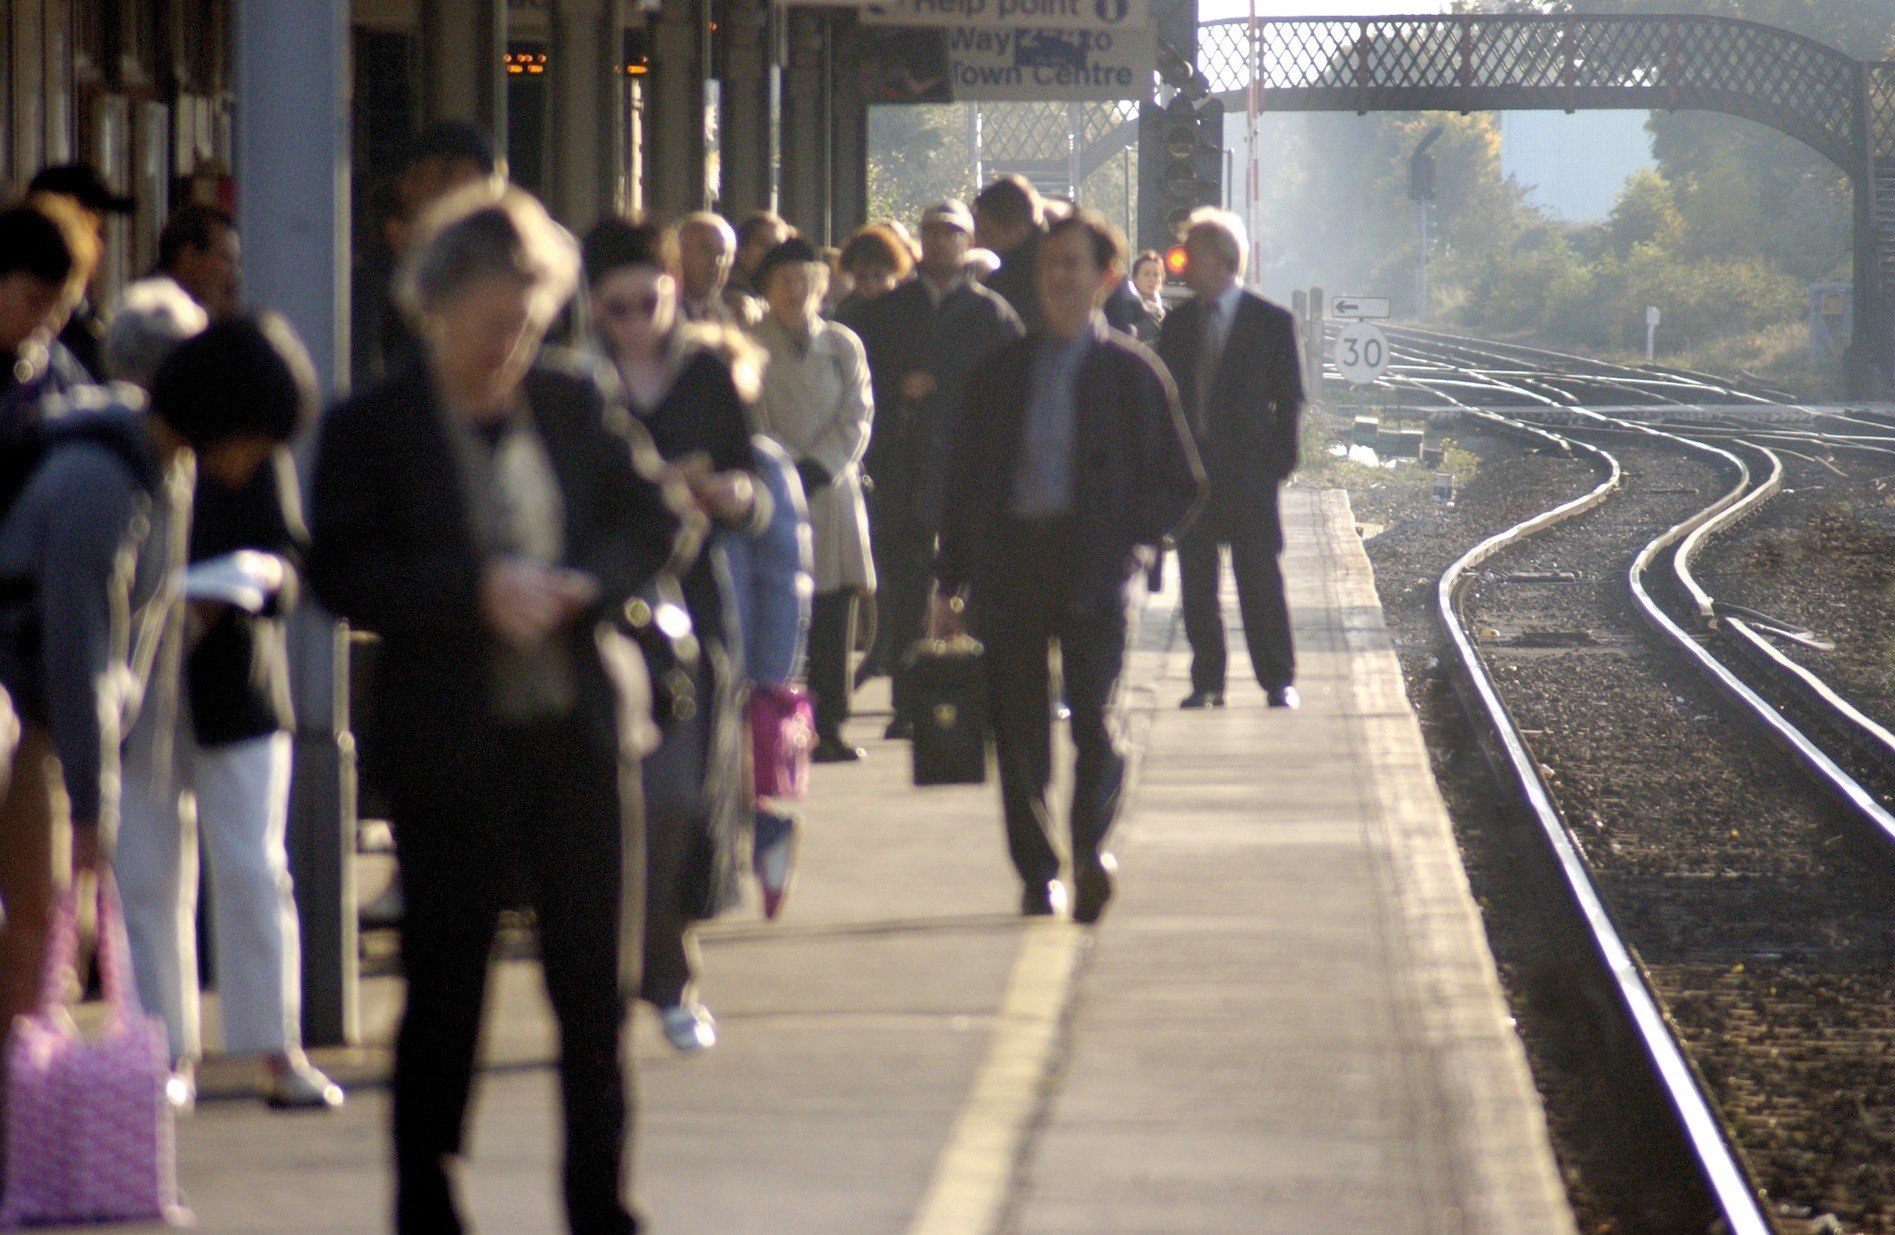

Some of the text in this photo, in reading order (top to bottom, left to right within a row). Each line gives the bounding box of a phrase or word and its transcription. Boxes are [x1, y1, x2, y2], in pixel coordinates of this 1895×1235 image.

[914, 0, 1080, 18] Help point
[951, 27, 1010, 54] Way
[952, 60, 1133, 85] Town Centre
[1343, 338, 1382, 368] 30
